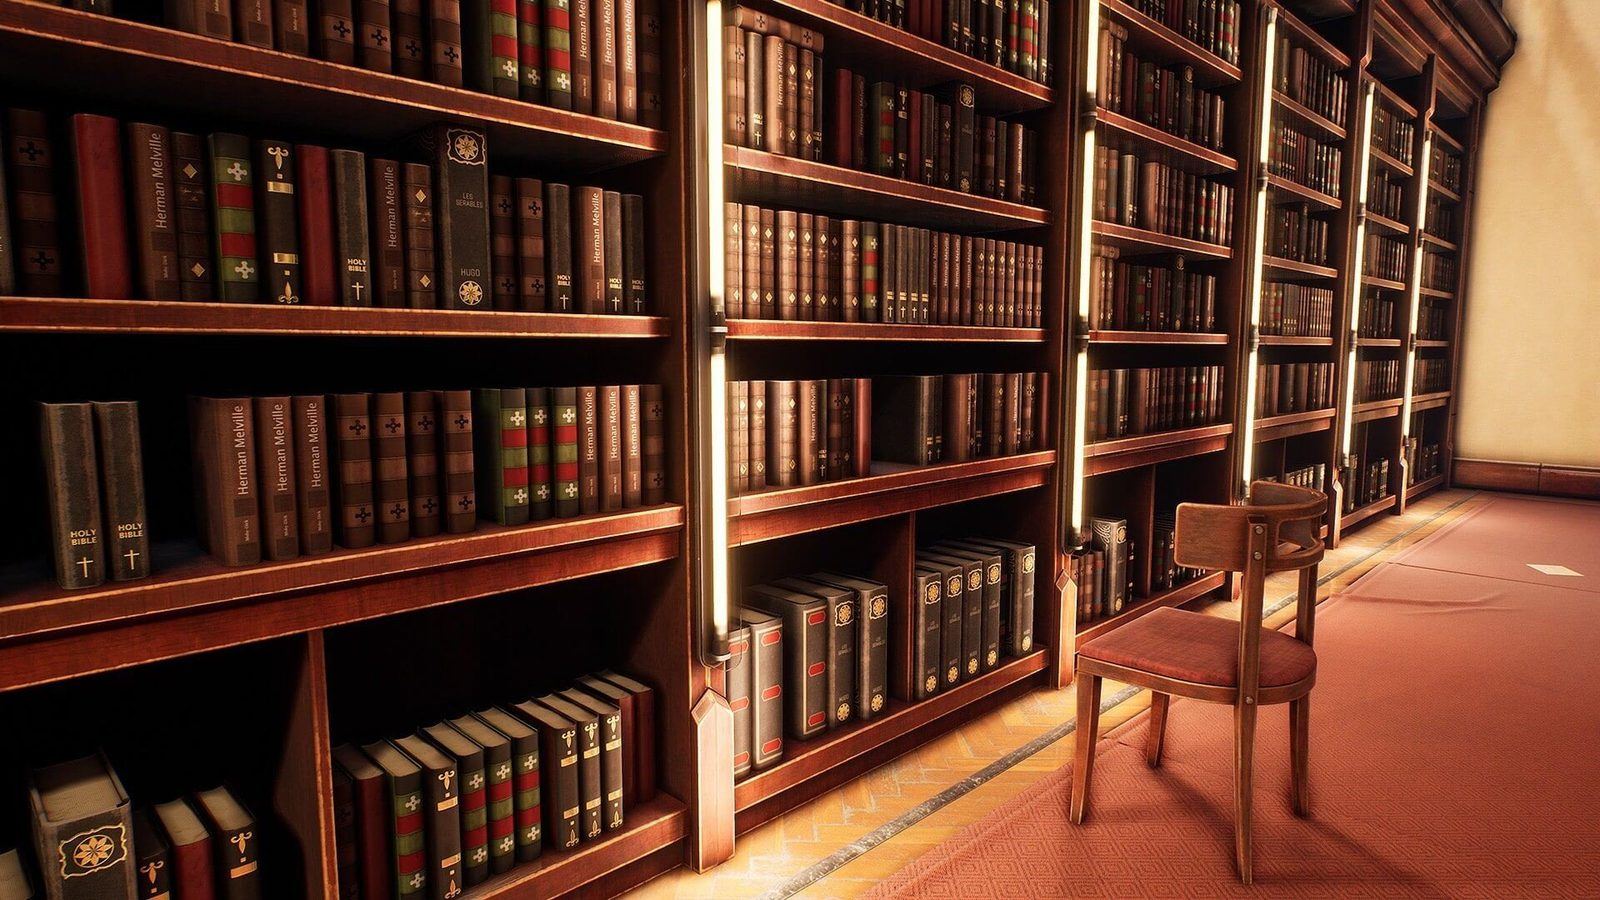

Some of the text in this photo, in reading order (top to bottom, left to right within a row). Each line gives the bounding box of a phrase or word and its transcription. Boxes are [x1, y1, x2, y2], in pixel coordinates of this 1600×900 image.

[604, 26, 612, 63] Herman
[149, 132, 167, 229] Herman Melville
[462, 192, 474, 200] LES
[384, 166, 397, 248] Herman Melville
[592, 192, 600, 226] Melville
[347, 258, 367, 266] HOLY
[460, 268, 480, 277] HUGO
[585, 392, 593, 424] Melville
[629, 390, 637, 420] Melville
[232, 405, 248, 495] Herman Melville
[272, 404, 287, 491] Herman Melville
[307, 402, 321, 487] Herman Melville
[70, 529, 97, 538] HOLY
[71, 537, 97, 546] BIBLE
[118, 523, 143, 532] HOLY
[119, 530, 144, 539] BIBLE
